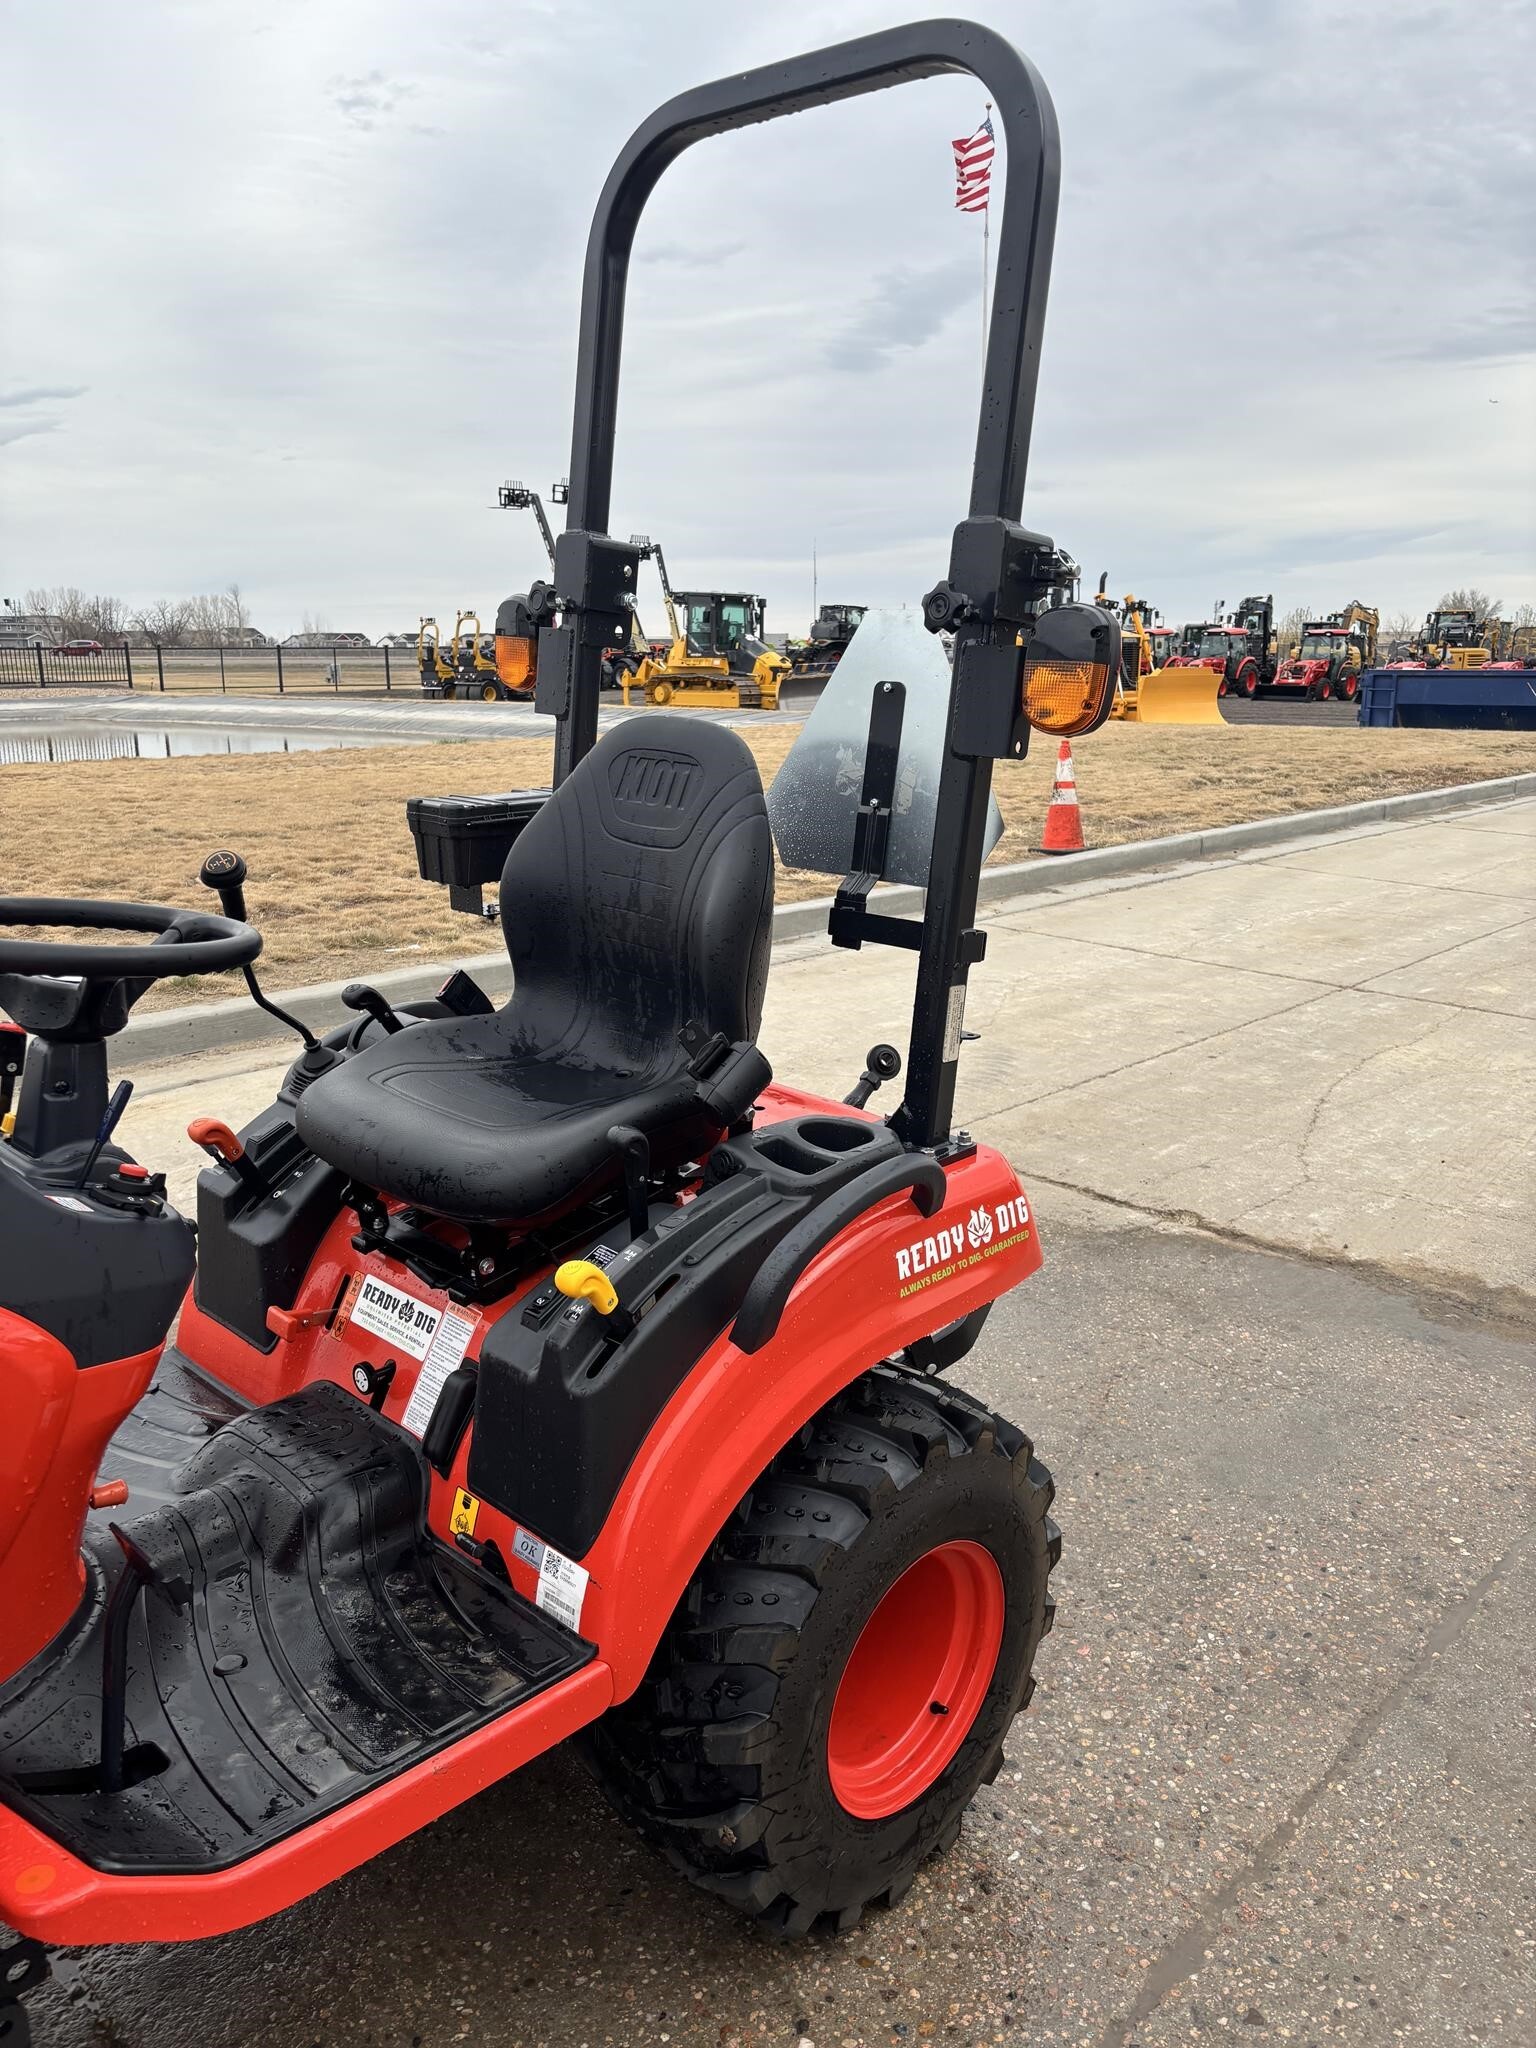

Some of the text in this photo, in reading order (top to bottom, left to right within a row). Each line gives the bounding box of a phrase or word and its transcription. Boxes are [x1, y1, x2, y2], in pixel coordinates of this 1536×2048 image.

[895, 1195, 1029, 1280] READY DIG
[900, 1229, 1030, 1298] ALWAYS READY TO DIG. GUARANTEED
[357, 1307, 378, 1321] EQUIPMENT
[408, 1336, 425, 1349] RENTALS
[362, 1283, 401, 1314] READY
[414, 1310, 437, 1335] DIG
[520, 1540, 538, 1558] OK
